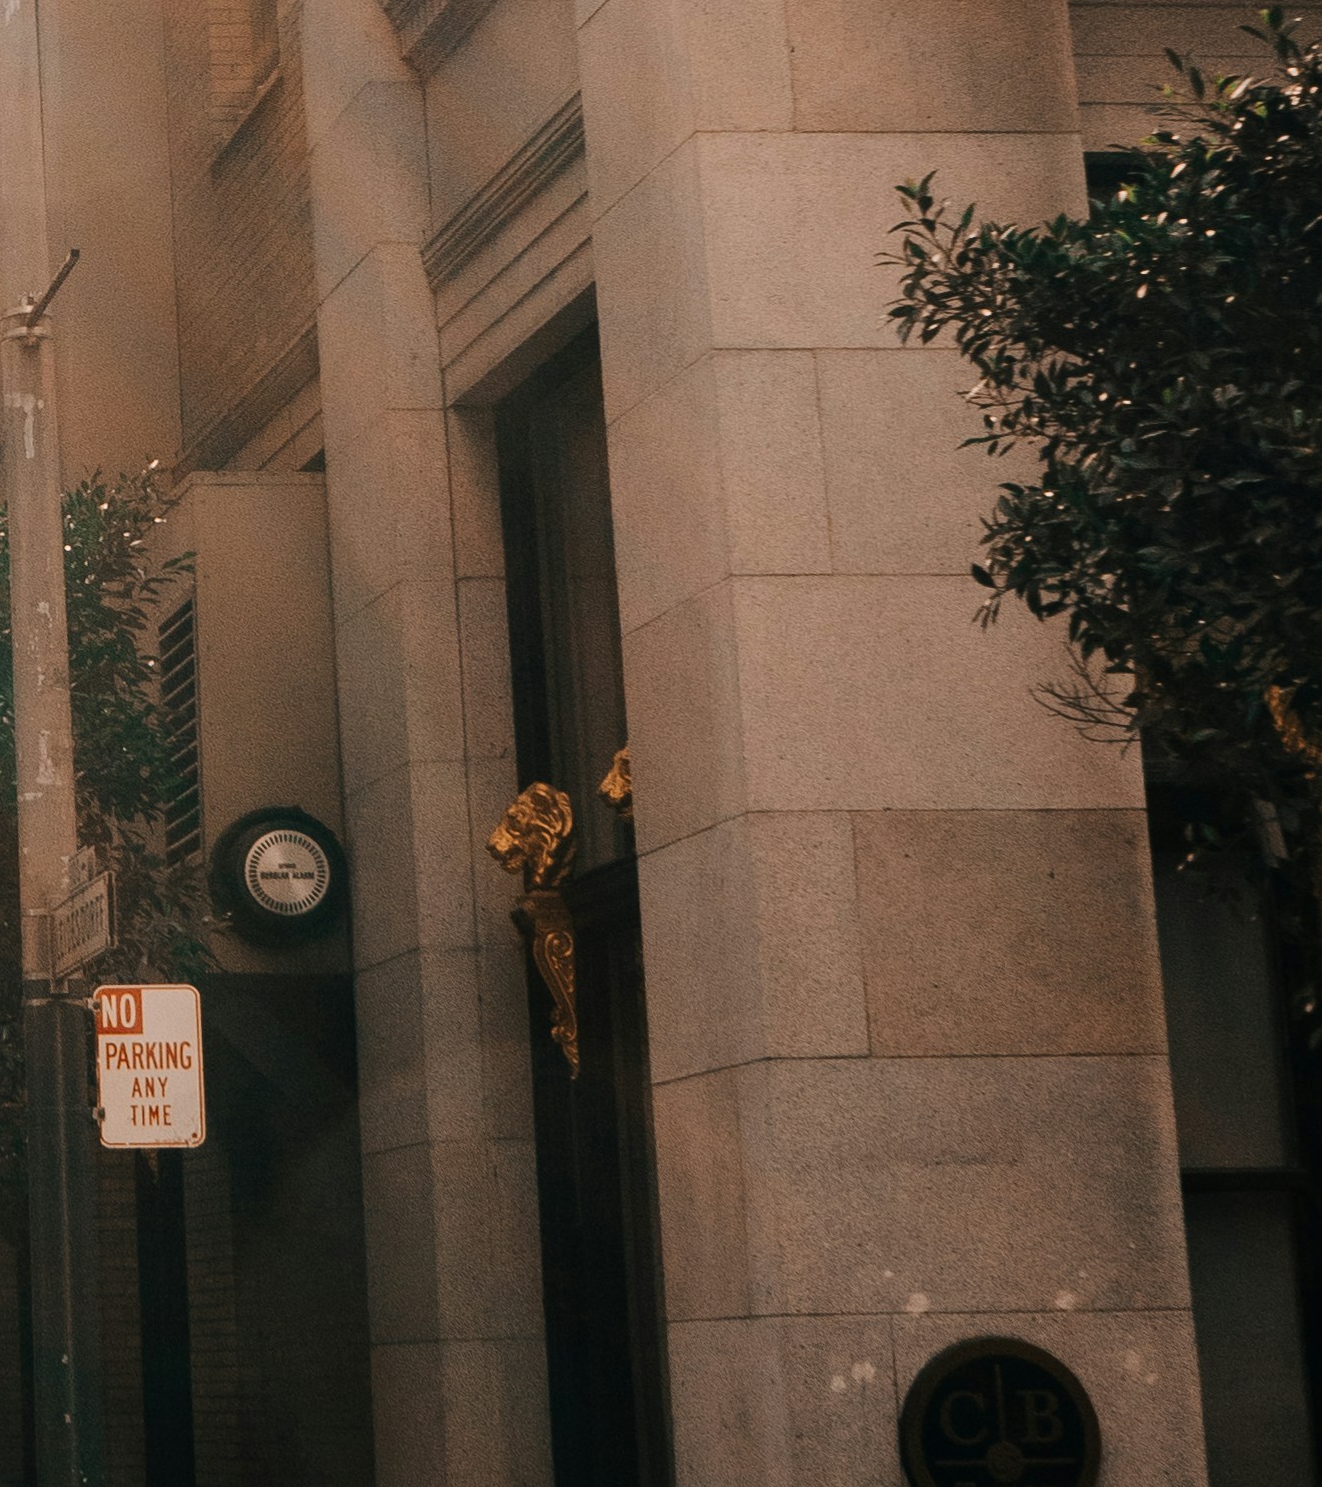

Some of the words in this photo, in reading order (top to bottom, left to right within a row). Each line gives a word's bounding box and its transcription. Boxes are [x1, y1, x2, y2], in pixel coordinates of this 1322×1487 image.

[101, 993, 137, 1029] NO
[104, 1040, 193, 1070] PARKING
[131, 1076, 169, 1098] ANY
[131, 1105, 172, 1127] TIME
